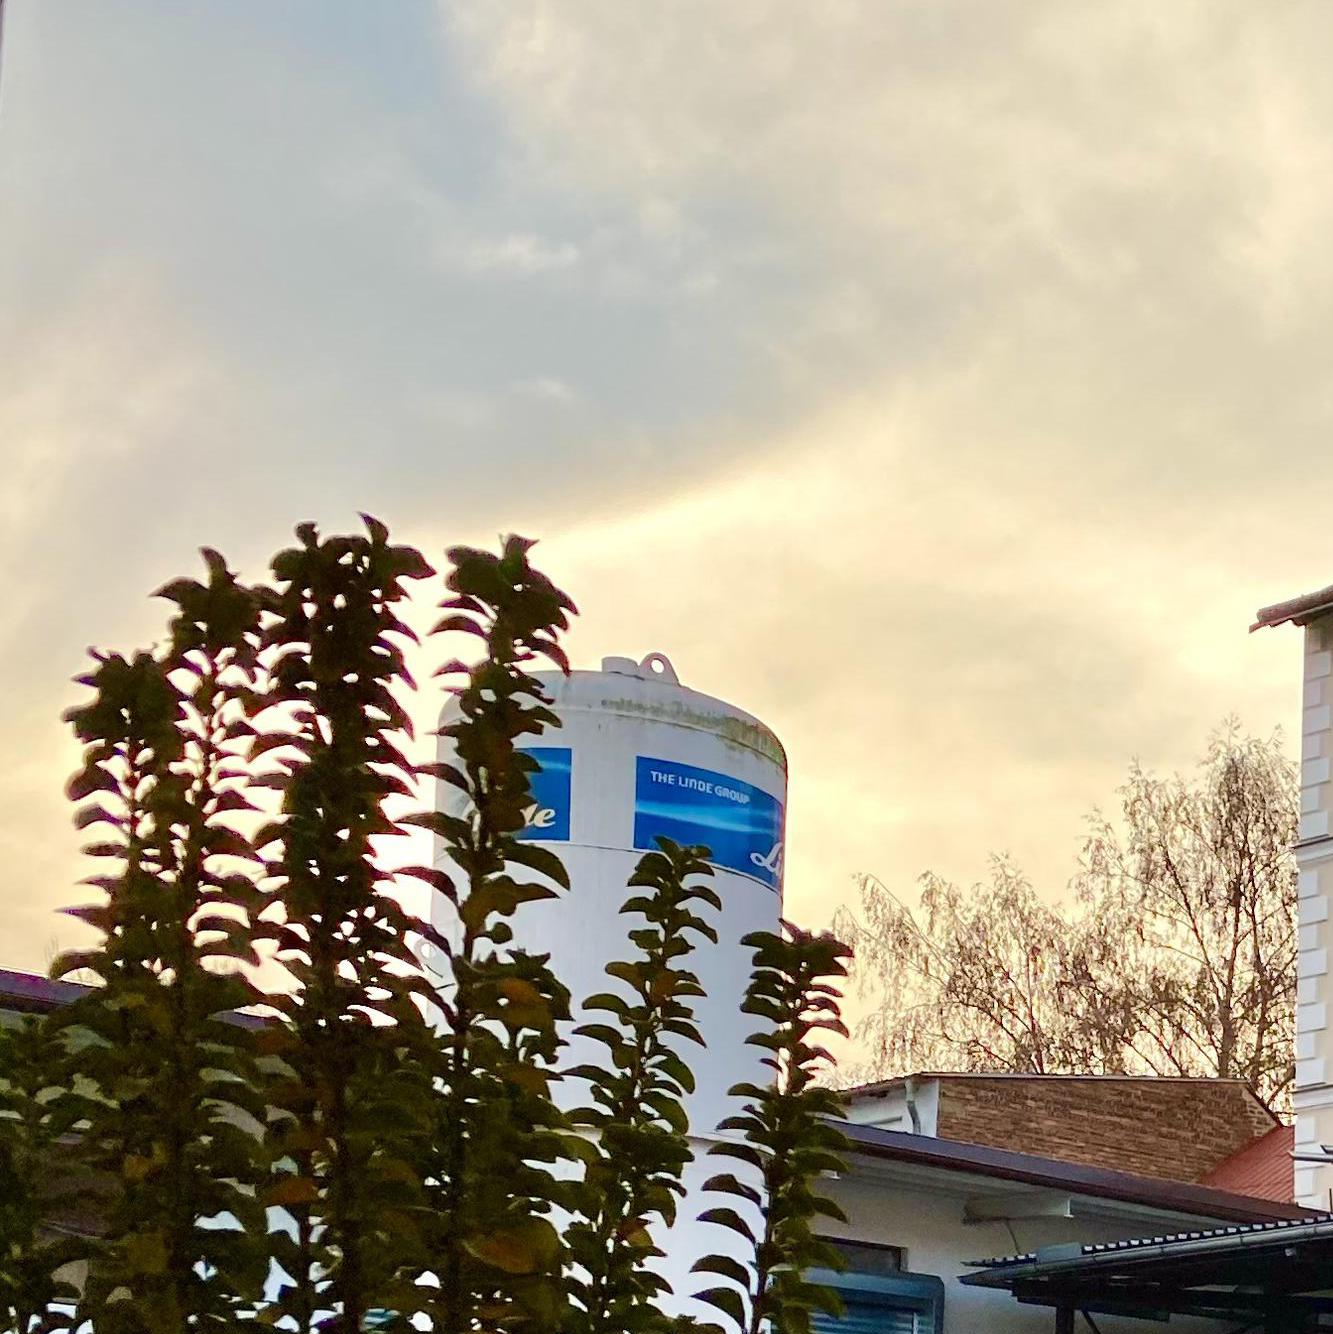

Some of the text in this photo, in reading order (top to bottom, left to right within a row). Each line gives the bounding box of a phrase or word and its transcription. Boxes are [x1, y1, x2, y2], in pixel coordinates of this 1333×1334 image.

[650, 770, 750, 804] THE LINDE GROUP
